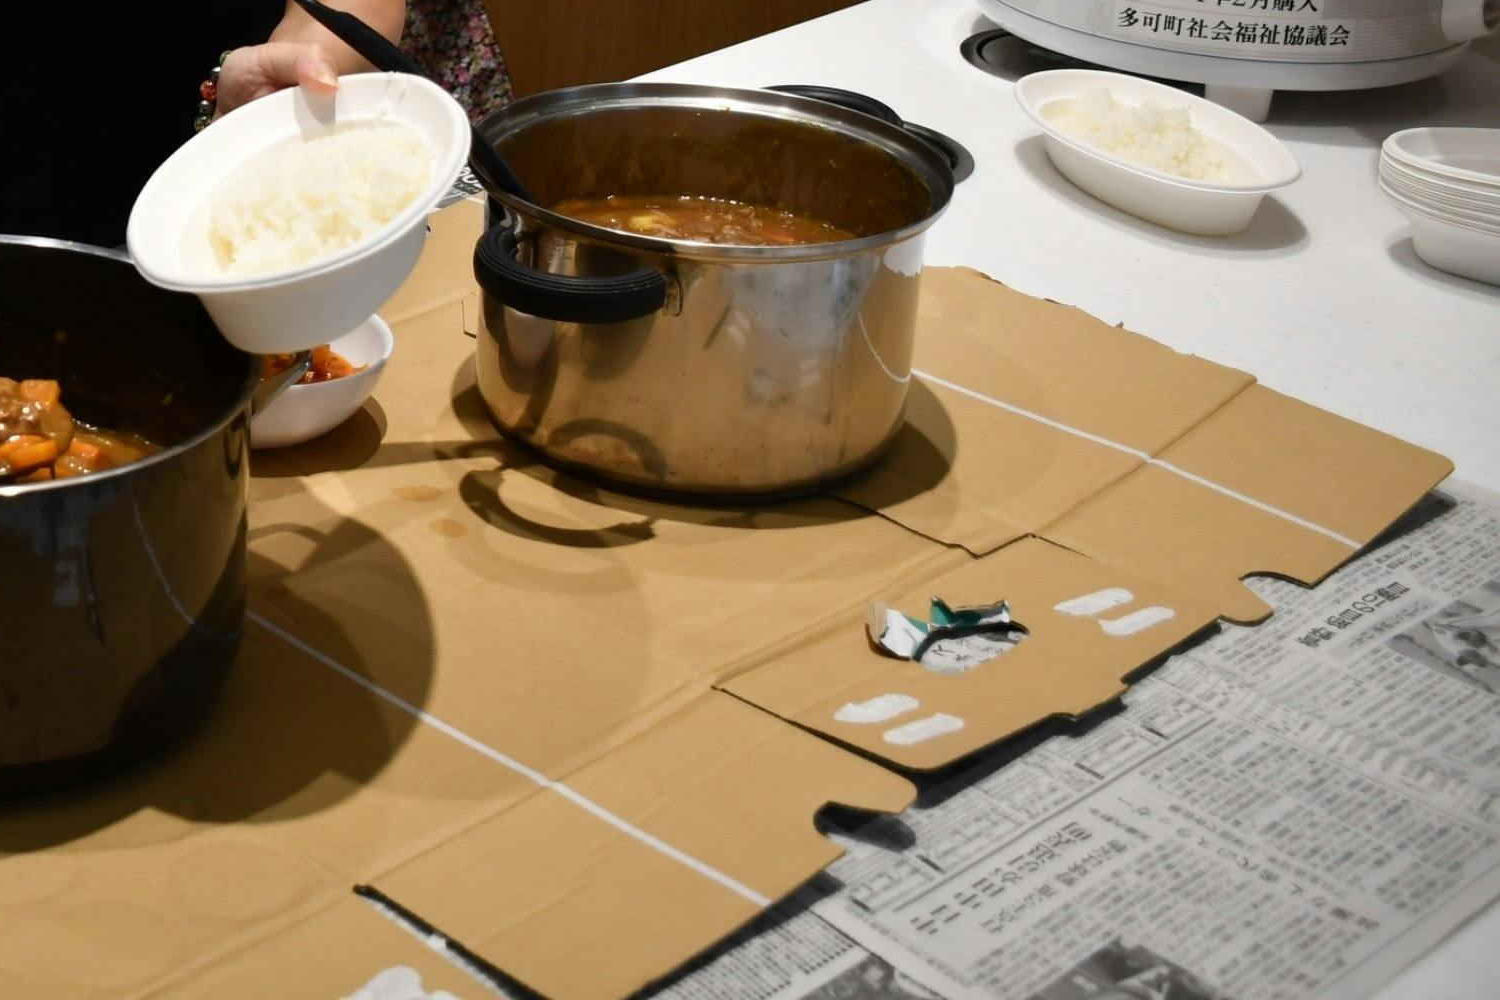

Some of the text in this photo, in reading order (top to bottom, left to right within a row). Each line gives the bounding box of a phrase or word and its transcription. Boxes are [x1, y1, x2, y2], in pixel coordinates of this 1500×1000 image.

[1117, 7, 1351, 46] 多可町社会福祉協議会
